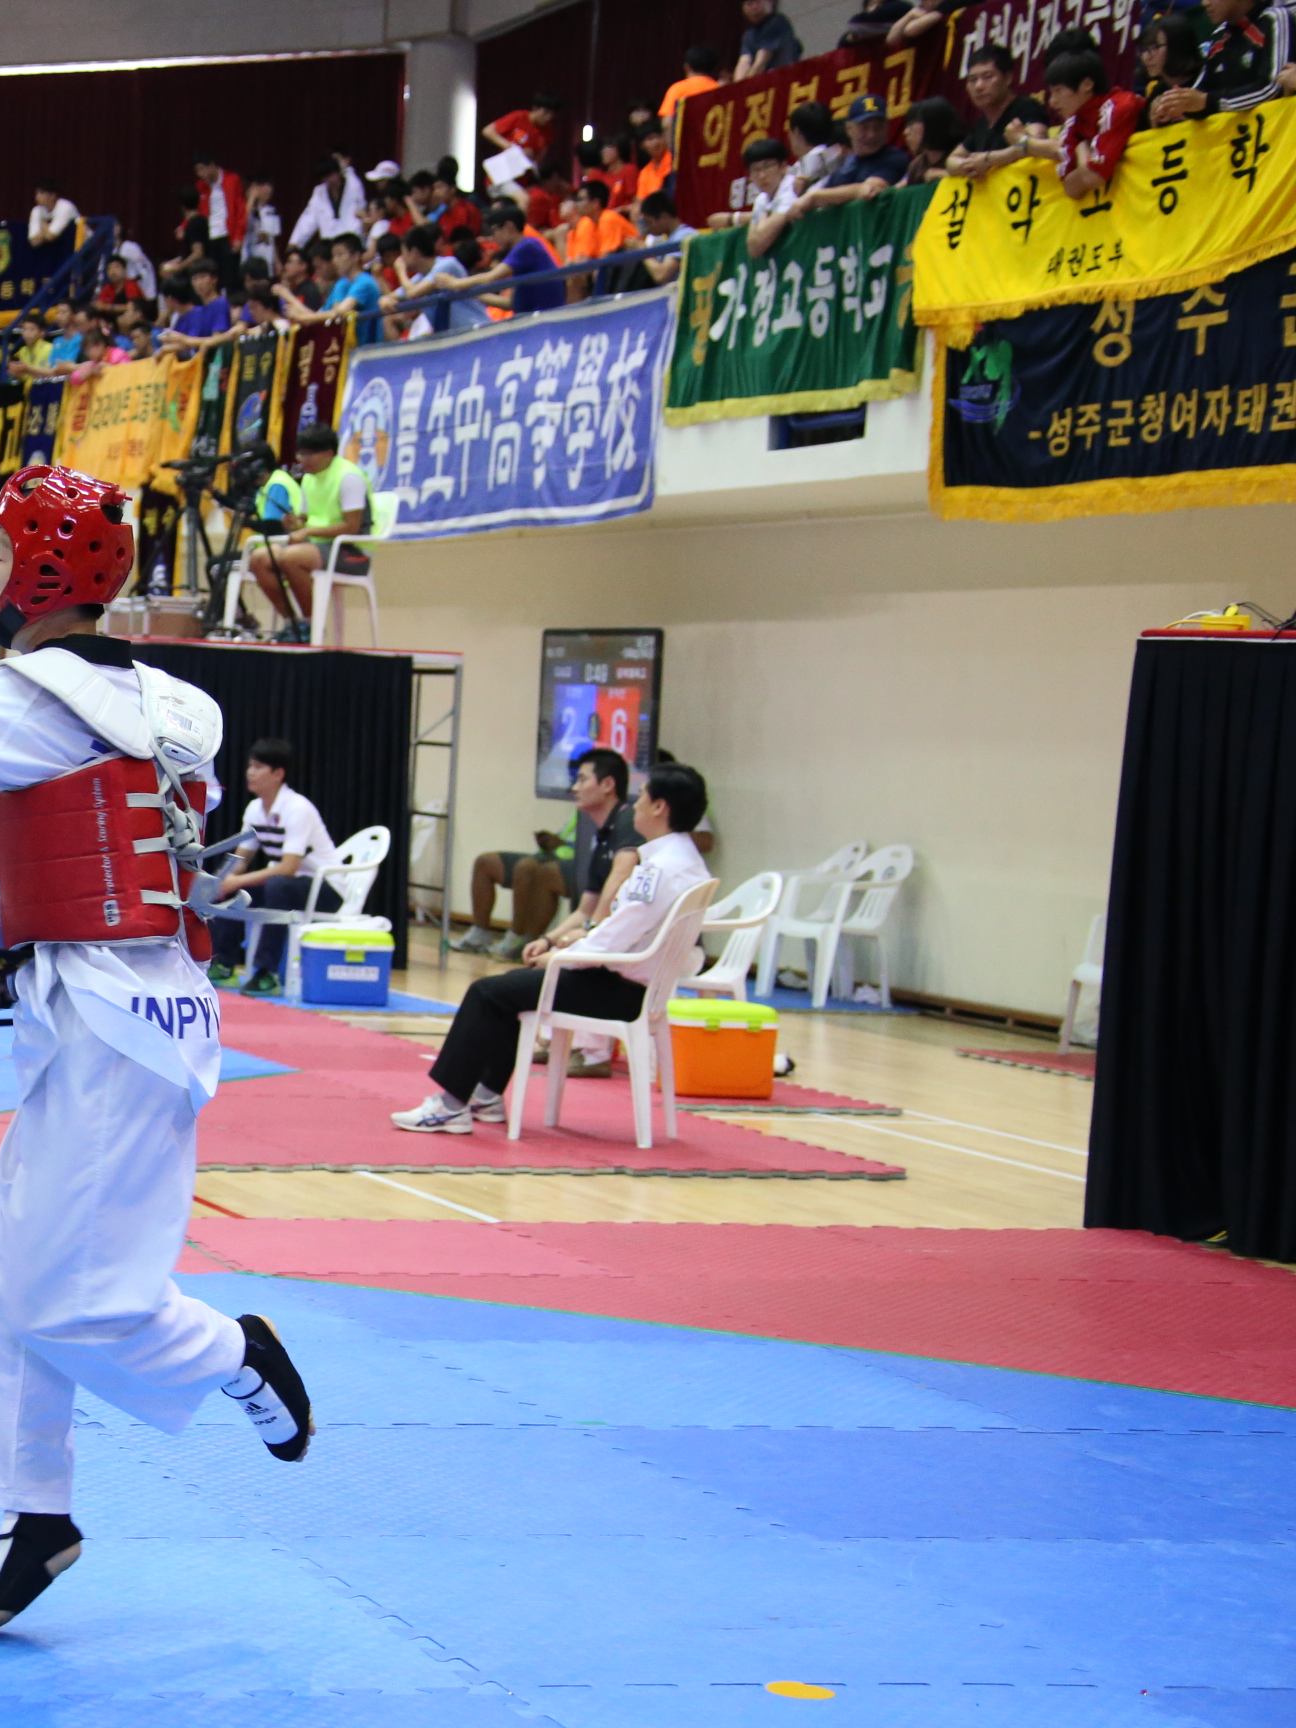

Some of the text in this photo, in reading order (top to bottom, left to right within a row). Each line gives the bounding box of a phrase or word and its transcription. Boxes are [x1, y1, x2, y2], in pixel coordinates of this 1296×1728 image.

[560, 706, 628, 753] 2 6
[92, 777, 106, 809] System
[96, 811, 108, 842] Scoring
